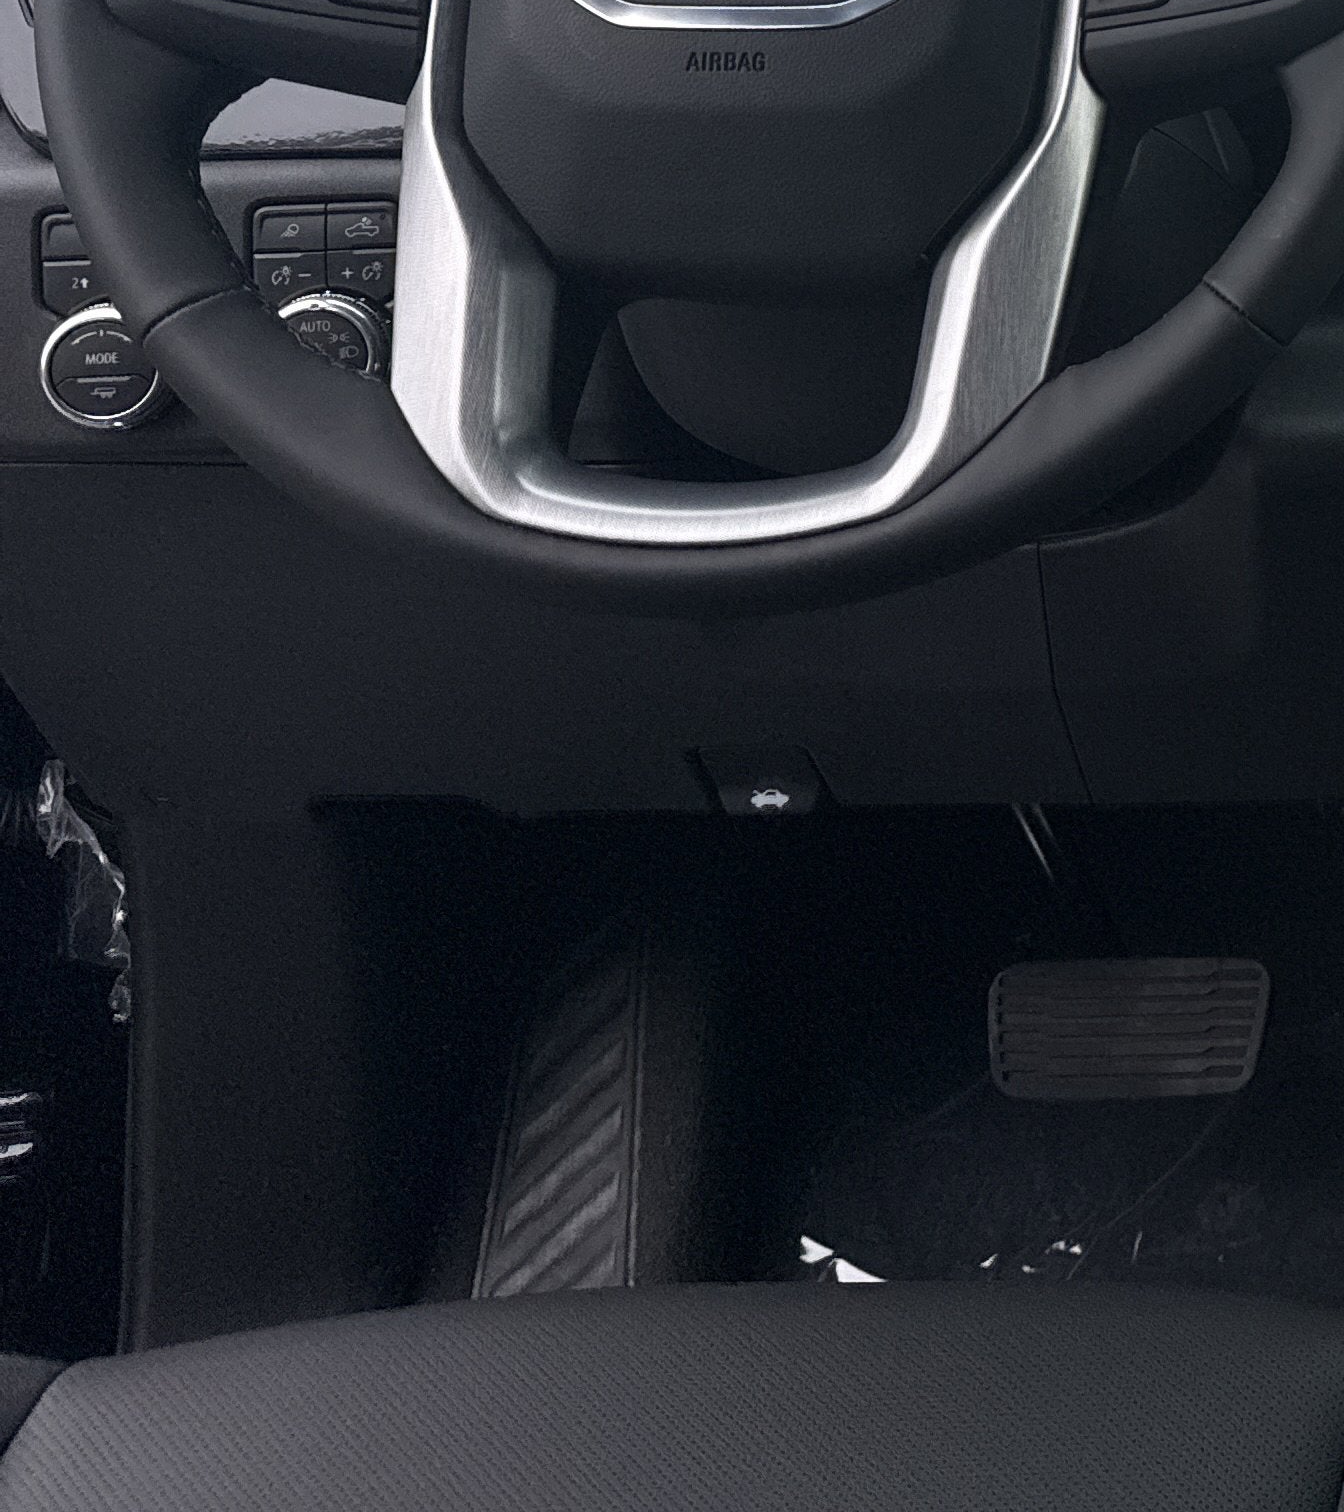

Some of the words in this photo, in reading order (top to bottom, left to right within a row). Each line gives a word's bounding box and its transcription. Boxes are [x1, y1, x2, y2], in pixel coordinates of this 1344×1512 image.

[685, 51, 766, 72] AIRBAG
[300, 320, 331, 333] AUTO
[85, 352, 119, 365] MODE
